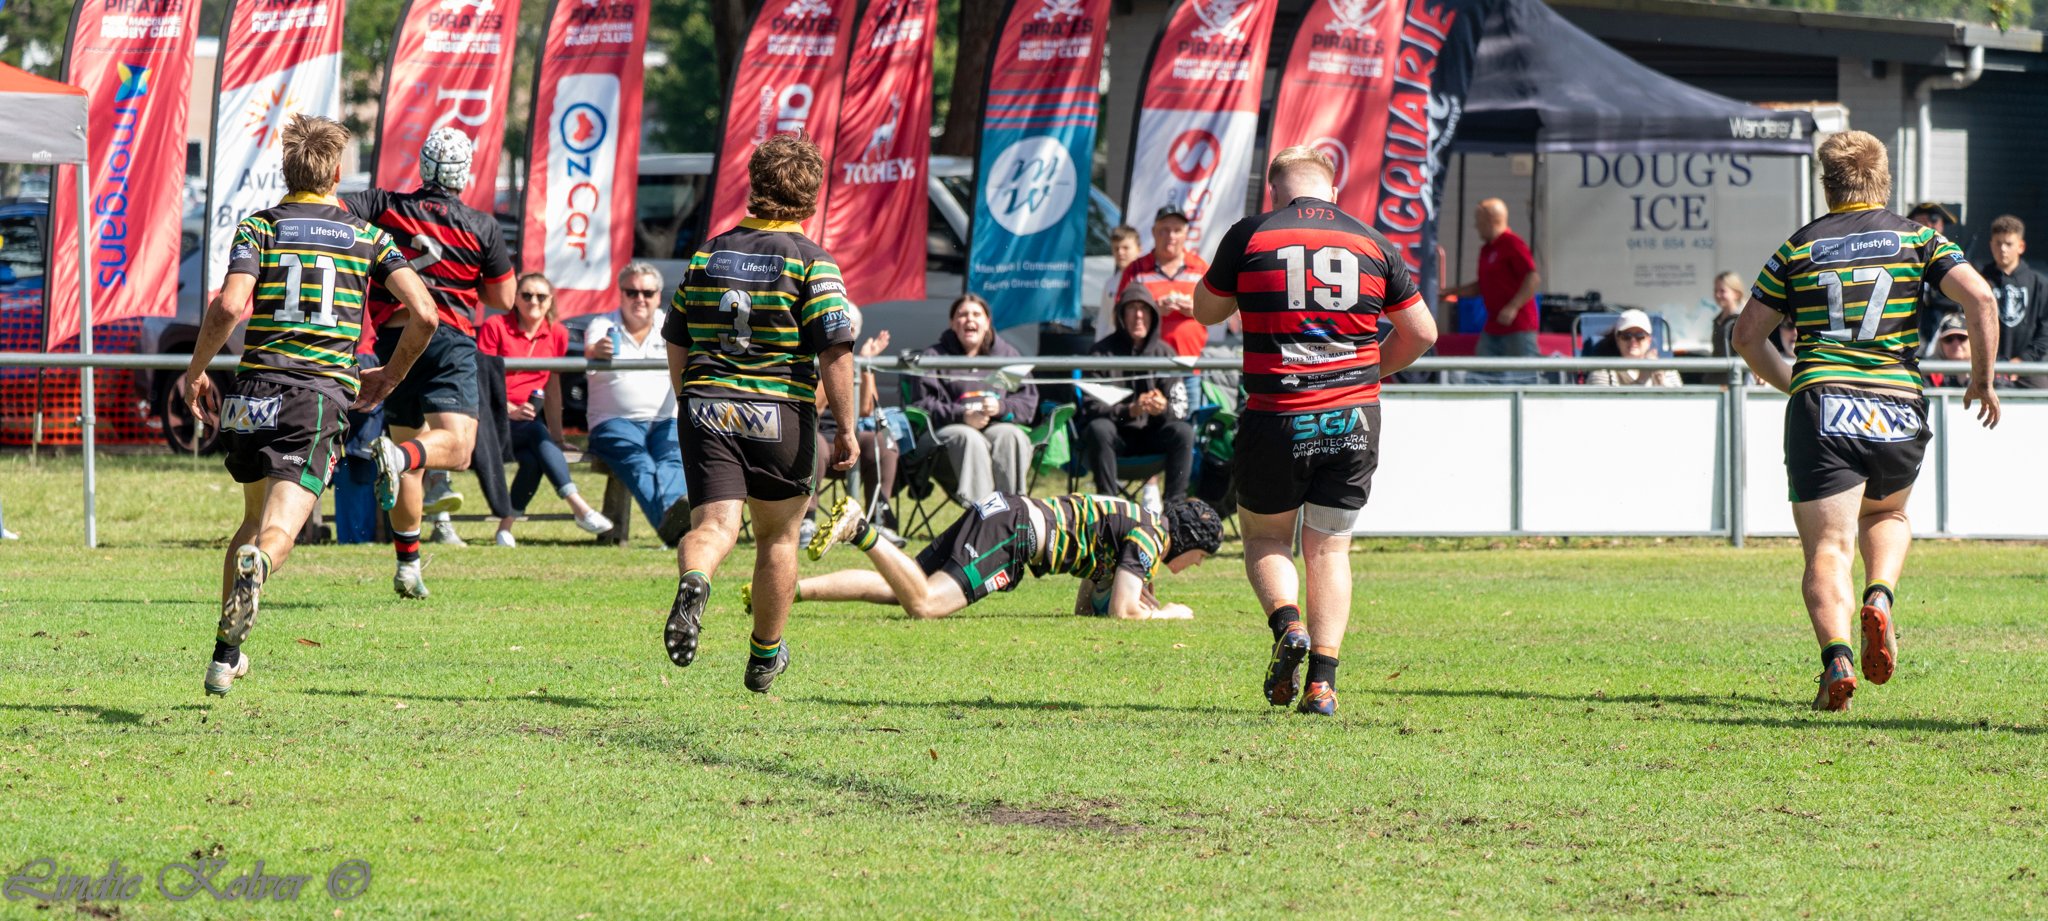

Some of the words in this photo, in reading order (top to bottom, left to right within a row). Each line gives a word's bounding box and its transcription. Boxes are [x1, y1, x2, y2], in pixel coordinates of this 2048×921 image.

[428, 12, 503, 29] PIRATES
[1311, 33, 1386, 55] PIRATES
[1578, 152, 1753, 188] DOUG'S
[95, 106, 139, 289] morgans
[419, 201, 449, 216] 1973
[1296, 207, 1336, 221] 1973
[1630, 193, 1709, 231] ICE
[273, 253, 338, 328] 11
[1276, 245, 1360, 311] 19
[717, 289, 753, 355] 3
[1818, 266, 1895, 341] 17
